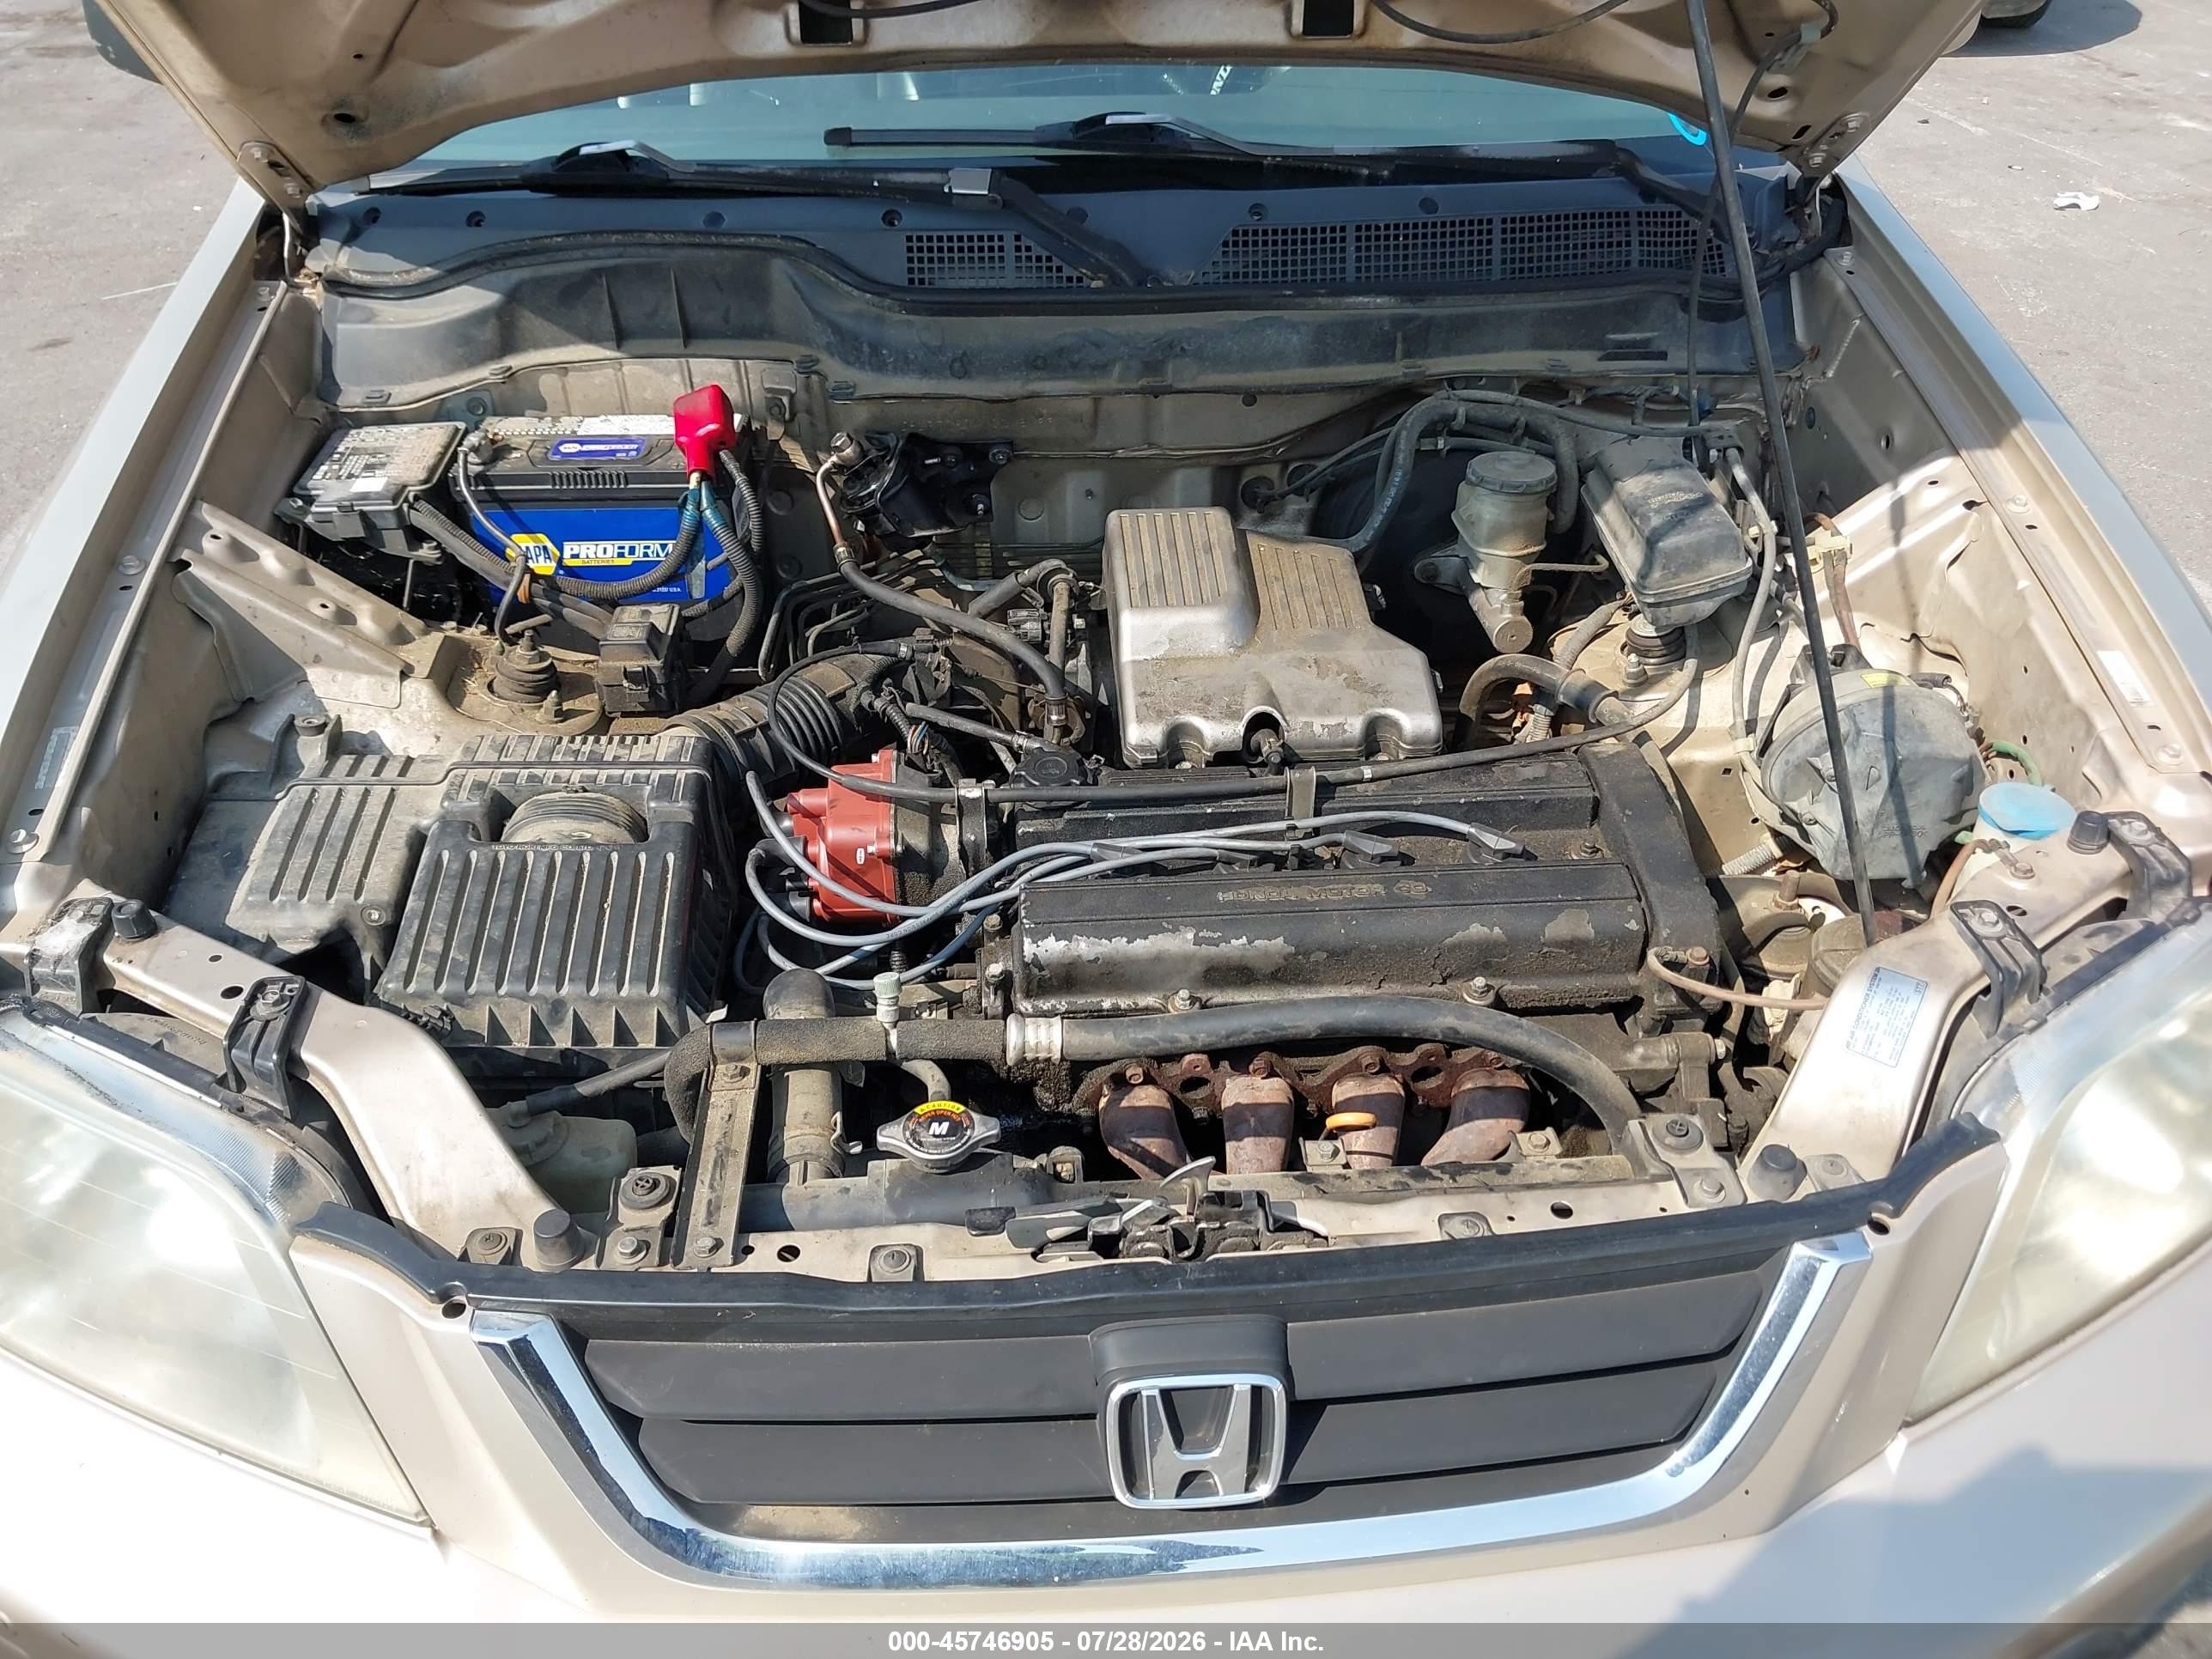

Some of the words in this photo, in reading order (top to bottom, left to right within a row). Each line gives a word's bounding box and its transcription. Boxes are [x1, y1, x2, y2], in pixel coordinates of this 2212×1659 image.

[523, 544, 552, 564] APA
[1216, 887, 1299, 902] HONDA
[1305, 883, 1386, 902] MOTOR
[1853, 993, 1871, 1030] CONDITIONER
[1867, 971, 1879, 993] SYSTEM
[926, 1103, 962, 1111] CAUTION
